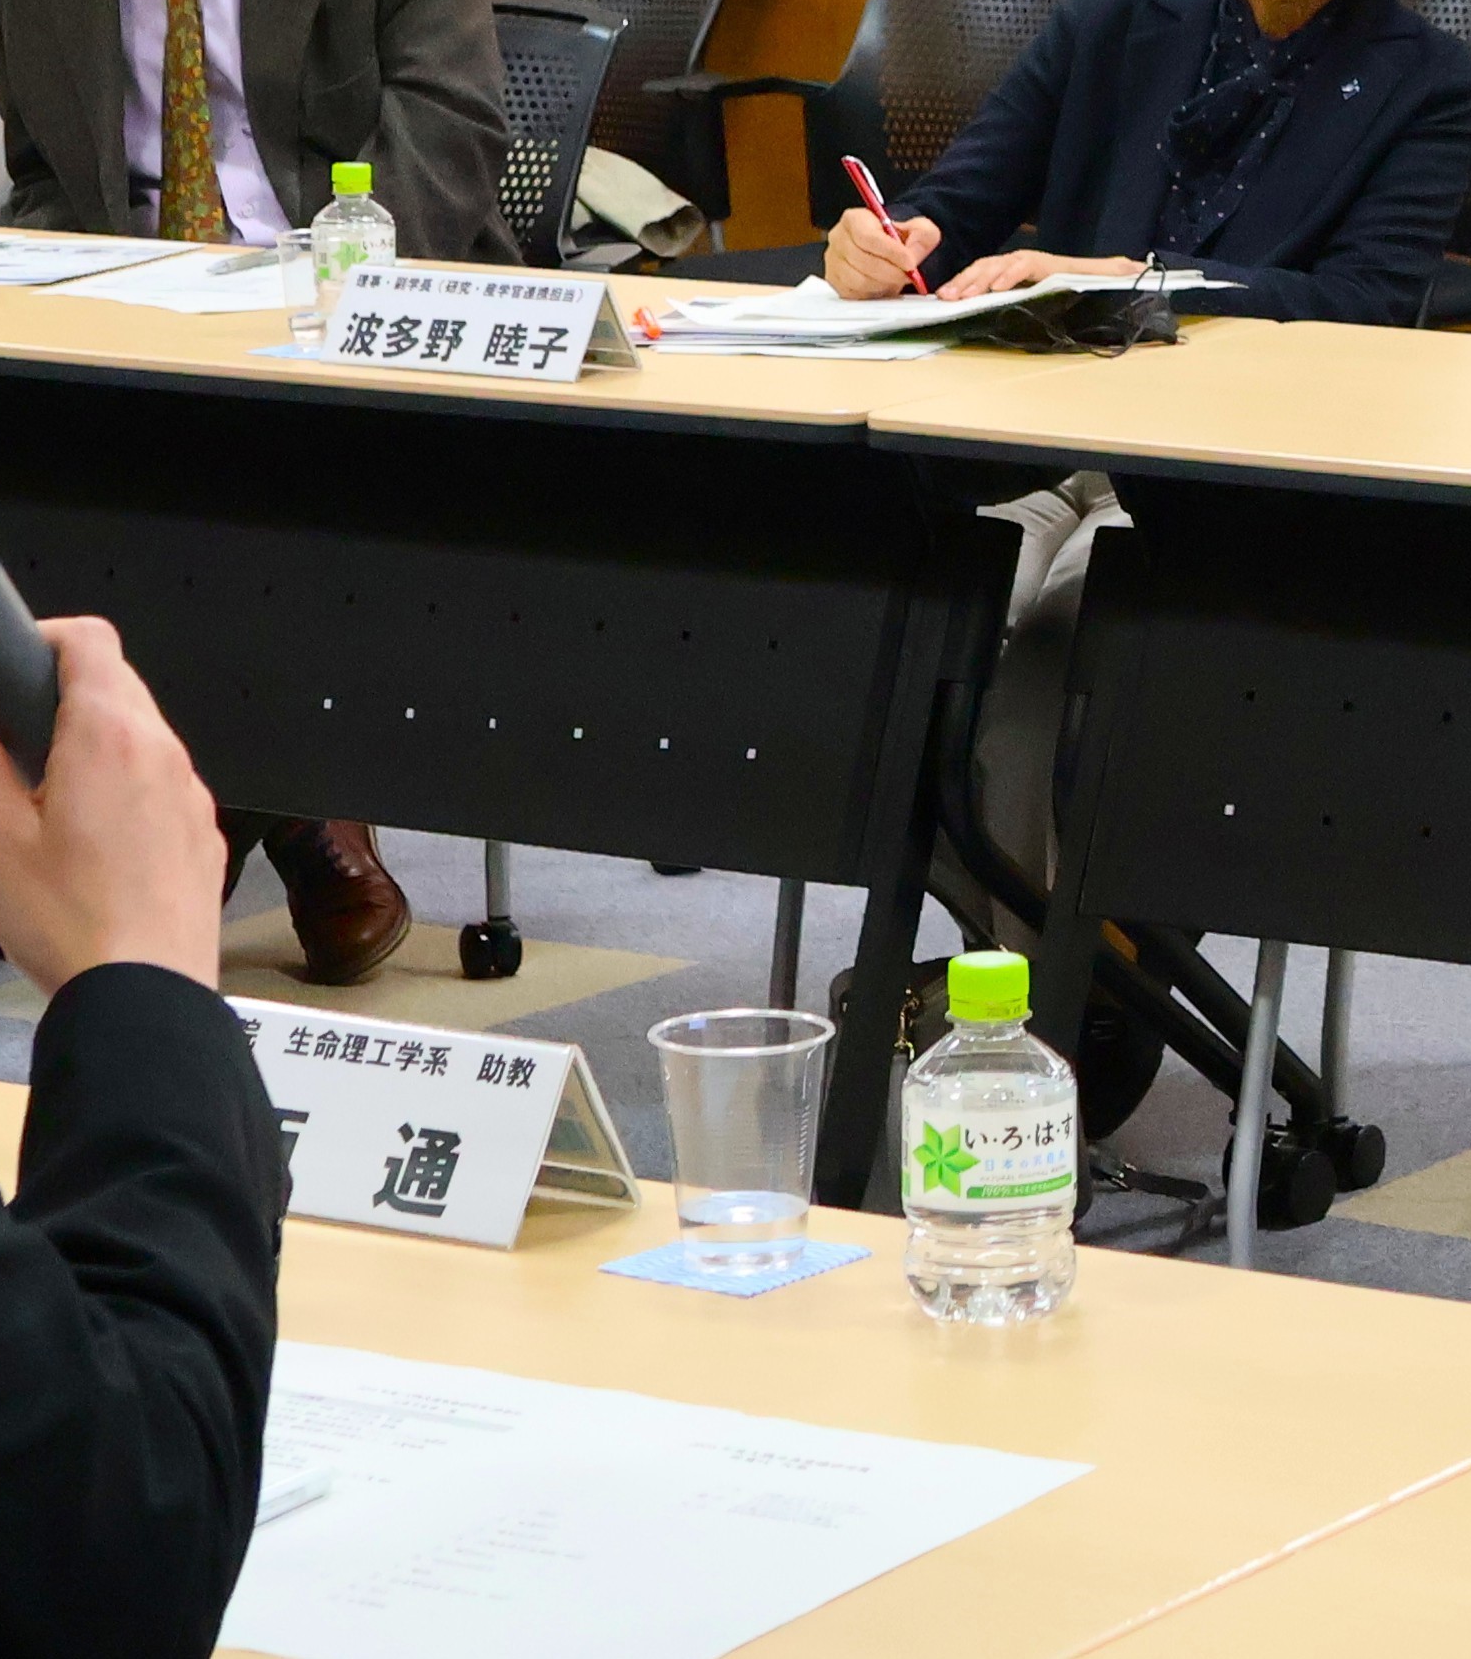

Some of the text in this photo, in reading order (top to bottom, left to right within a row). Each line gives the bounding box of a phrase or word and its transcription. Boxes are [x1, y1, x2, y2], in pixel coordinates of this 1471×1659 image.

[339, 312, 570, 370] 波多野 睦子
[284, 1025, 452, 1077] 生命理工学系
[476, 1053, 537, 1089] 助教
